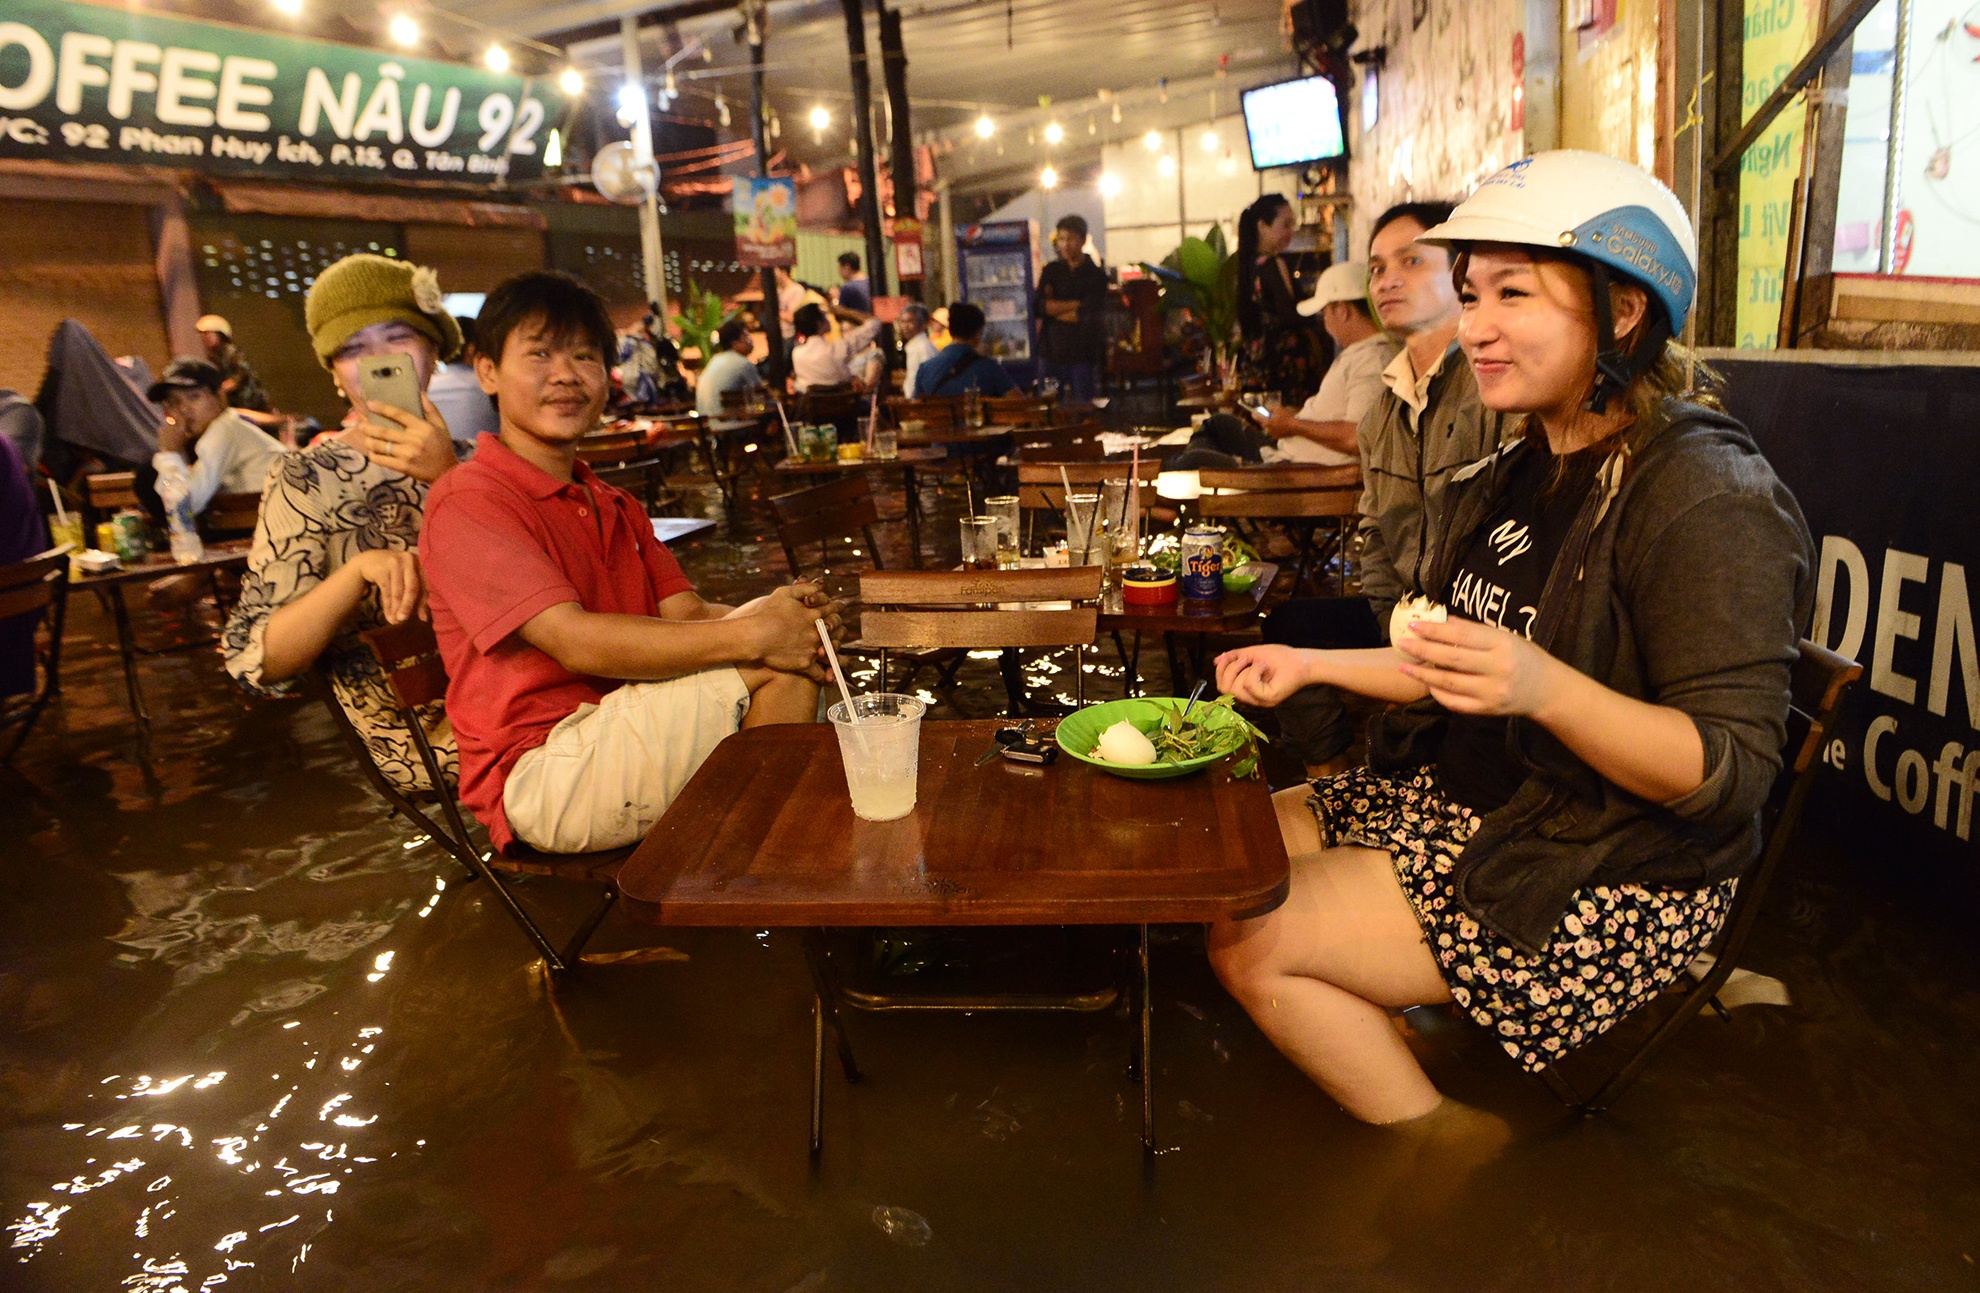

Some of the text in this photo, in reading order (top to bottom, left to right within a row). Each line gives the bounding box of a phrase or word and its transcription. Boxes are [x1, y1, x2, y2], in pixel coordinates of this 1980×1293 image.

[0, 22, 544, 155] OFFEE NÂU 92
[60, 122, 110, 149] 92
[119, 127, 204, 156] Phan
[211, 134, 272, 164] Huy
[1612, 224, 1657, 254] SAMSUNG
[1190, 560, 1221, 577] Tiger
